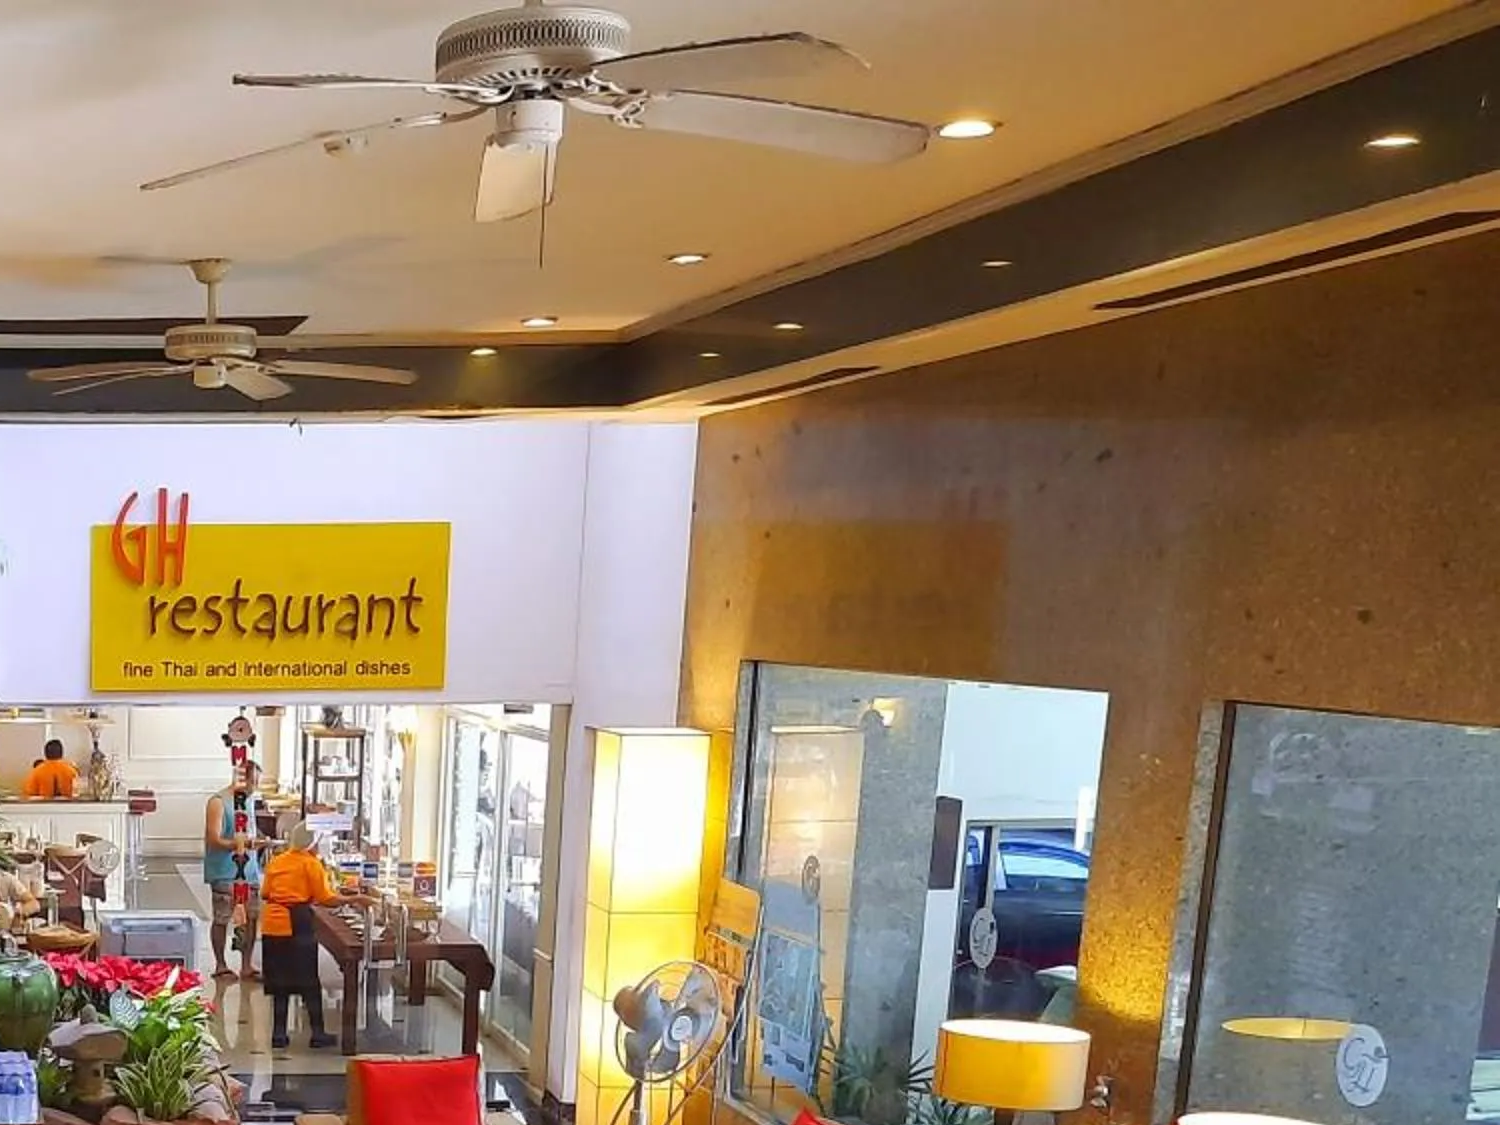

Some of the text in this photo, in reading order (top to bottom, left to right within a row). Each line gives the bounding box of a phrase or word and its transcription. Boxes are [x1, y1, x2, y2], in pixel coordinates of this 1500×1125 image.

[111, 488, 189, 586] GH
[148, 576, 423, 641] restaurant
[123, 661, 153, 678] fine
[161, 660, 197, 677] Thai
[205, 660, 237, 677] and
[355, 659, 412, 676] dishes
